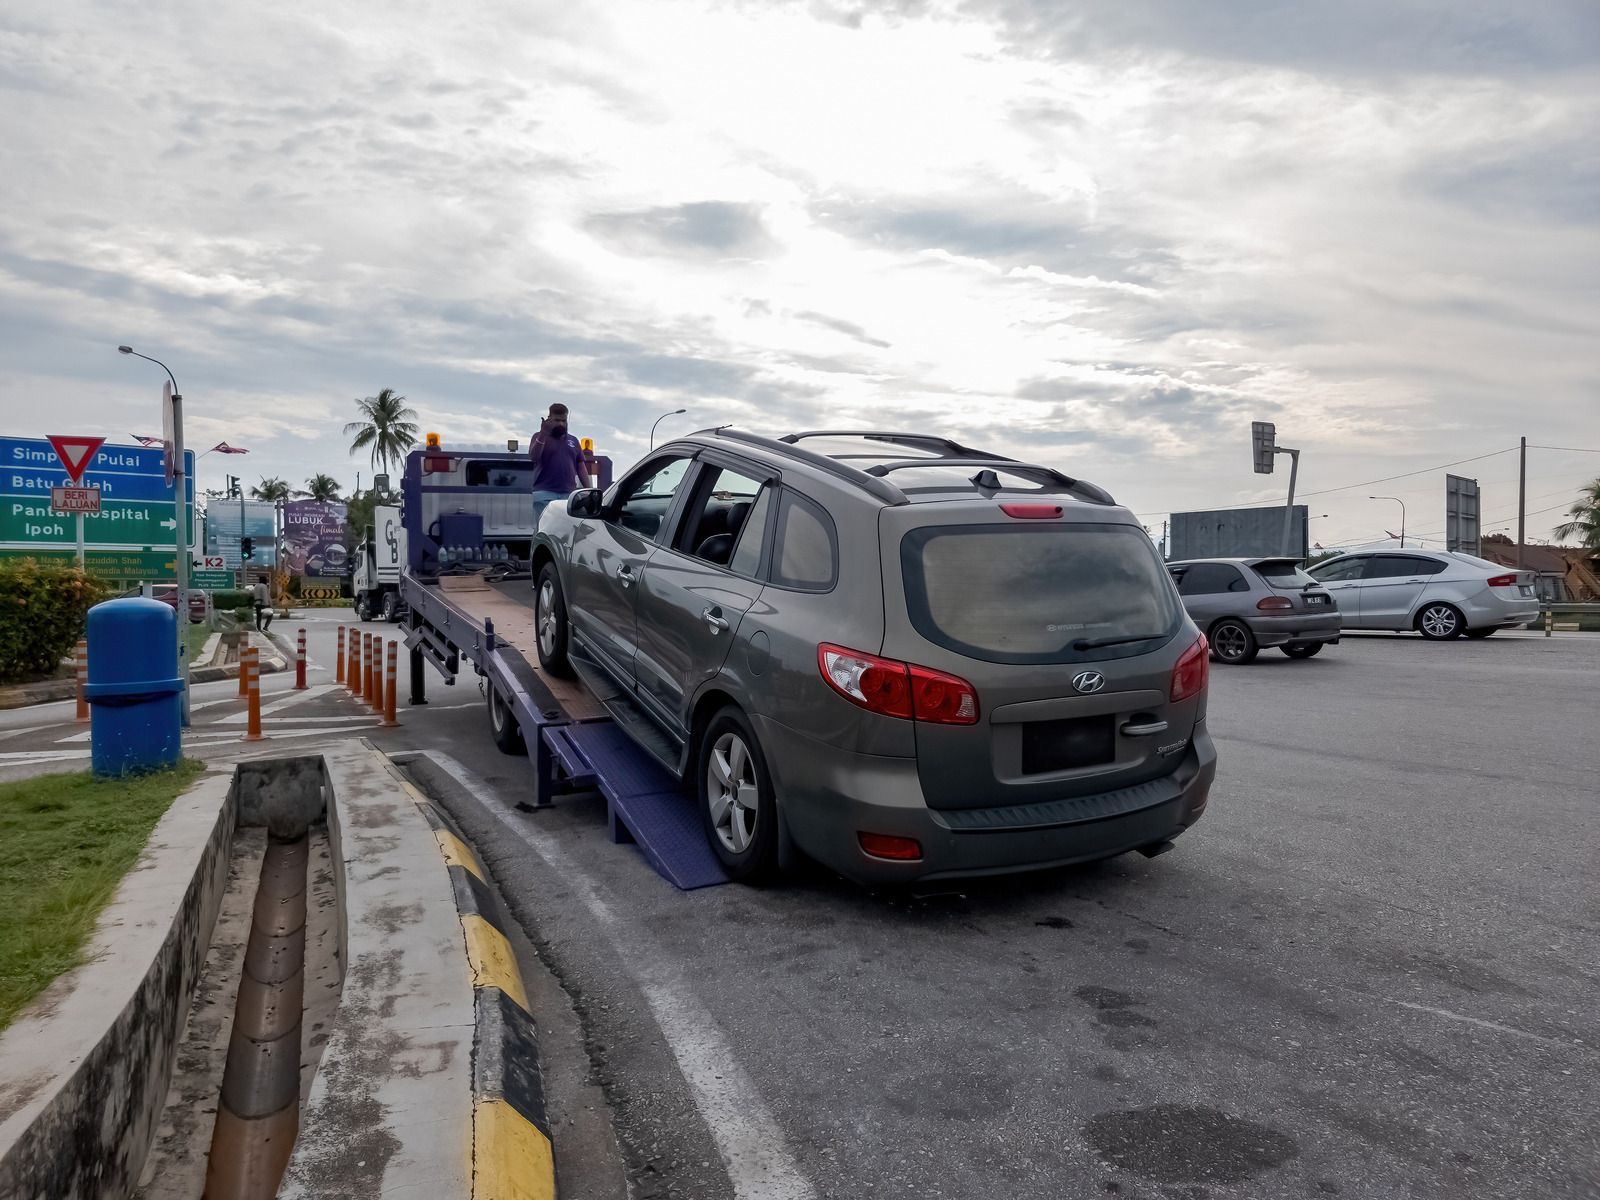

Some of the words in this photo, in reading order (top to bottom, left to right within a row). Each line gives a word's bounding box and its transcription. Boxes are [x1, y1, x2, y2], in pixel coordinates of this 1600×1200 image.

[13, 447, 59, 463] Simp
[97, 453, 140, 467] Pulai
[12, 475, 54, 489] Batu
[61, 478, 112, 492] Gah
[64, 490, 88, 500] BERI
[54, 500, 98, 510] LALUAN
[288, 516, 324, 525] LUBUK
[25, 523, 64, 537] Ipoh
[121, 557, 142, 566] Shah
[205, 557, 224, 568] K2
[84, 566, 121, 575] ultimedia
[124, 567, 159, 577] Malaysia
